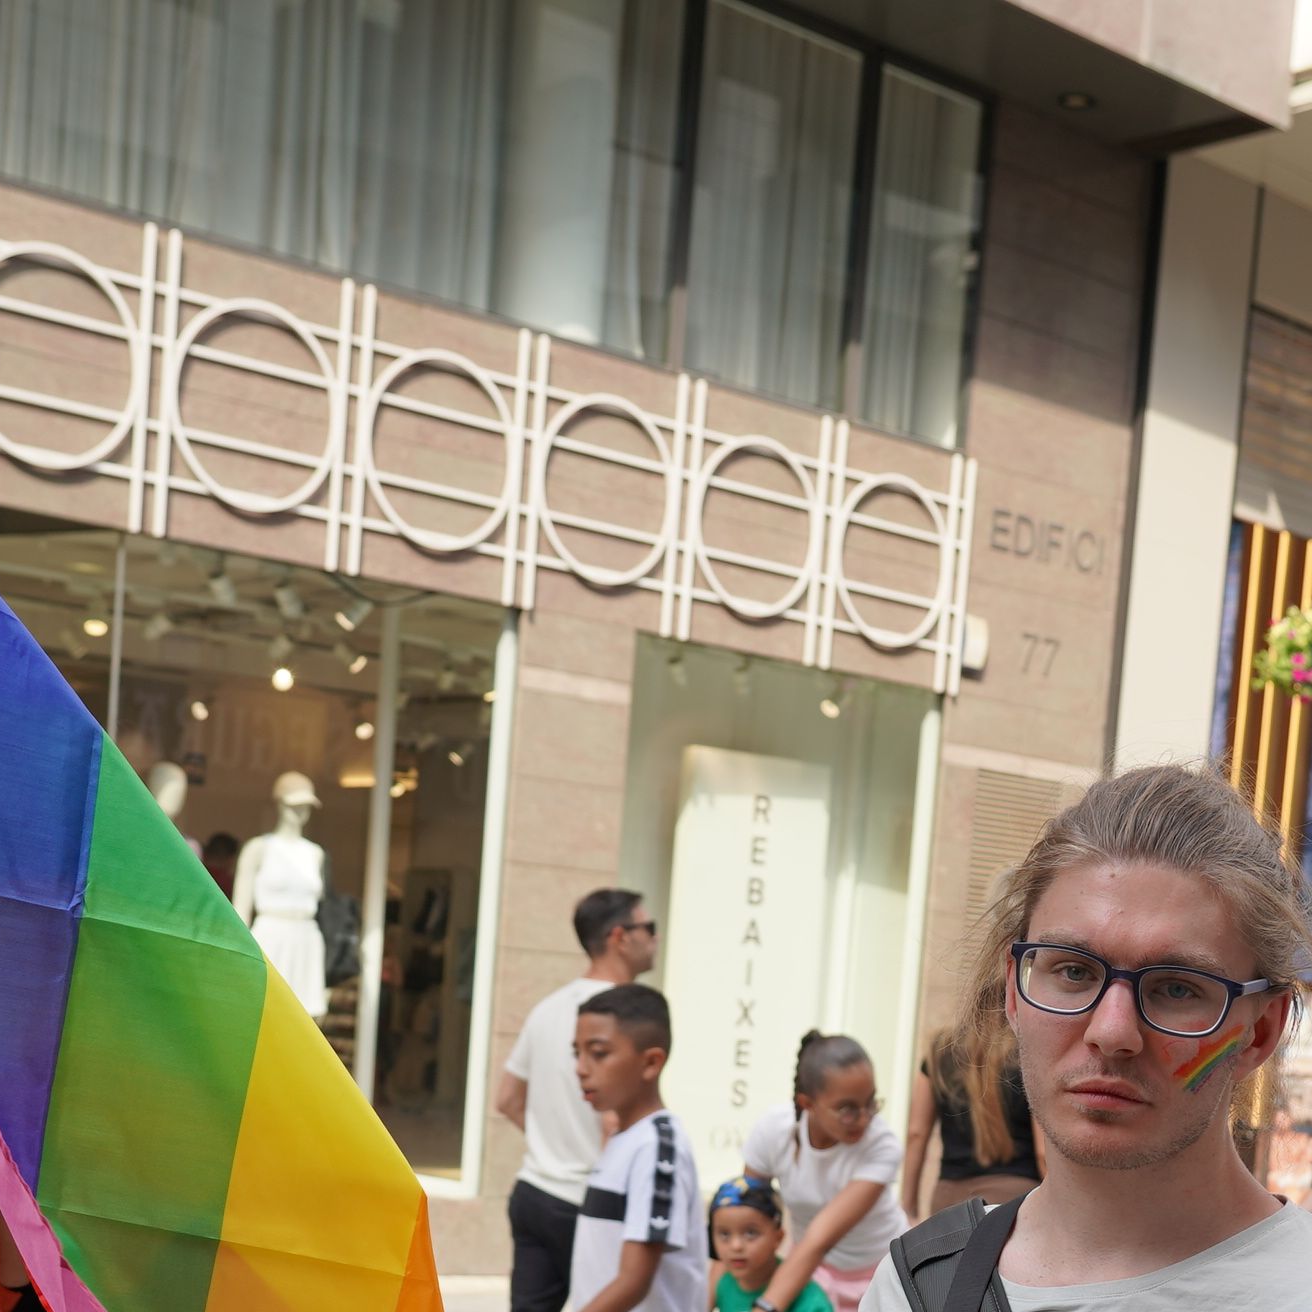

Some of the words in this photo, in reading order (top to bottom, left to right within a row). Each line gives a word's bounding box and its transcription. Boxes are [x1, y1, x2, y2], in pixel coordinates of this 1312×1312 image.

[991, 510, 1106, 574] EDIFICI
[1022, 633, 1061, 677] 77
[731, 795, 772, 1108] REBAIXES
